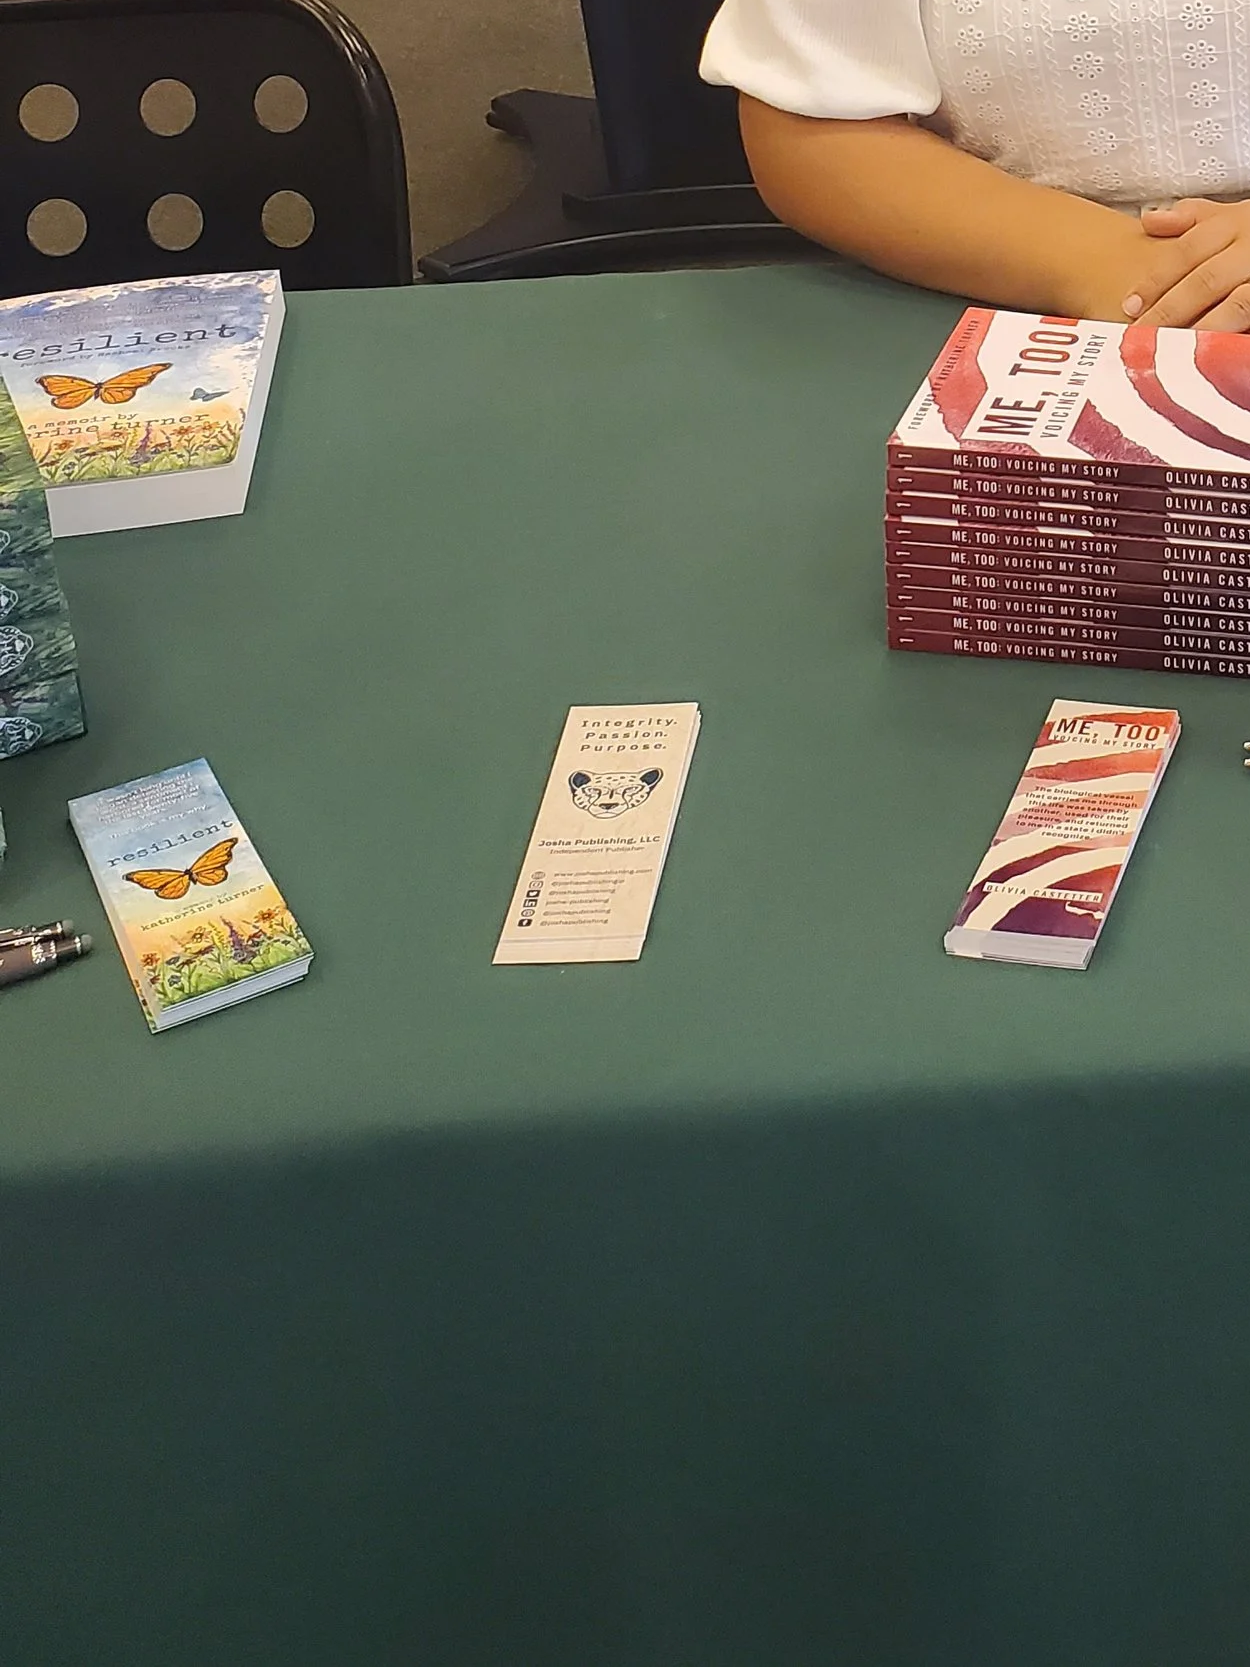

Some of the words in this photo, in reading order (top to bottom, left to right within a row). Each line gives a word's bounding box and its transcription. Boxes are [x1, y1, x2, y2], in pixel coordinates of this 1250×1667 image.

[953, 454, 975, 467] ME,
[1006, 459, 1056, 475] VOICING
[1061, 464, 1077, 476] MY
[1083, 466, 1120, 479] STORY
[1165, 471, 1213, 488] OLIVIA
[586, 731, 668, 740] Passion.
[1056, 718, 1098, 738] ME,
[1114, 724, 1161, 740] TOO
[580, 743, 666, 752] Purpose.
[106, 820, 234, 867] resilient
[538, 839, 571, 847] Josha
[574, 837, 636, 846] Publishing,
[986, 885, 1027, 896] OLIVIA
[1034, 890, 1100, 902] CASTETTER
